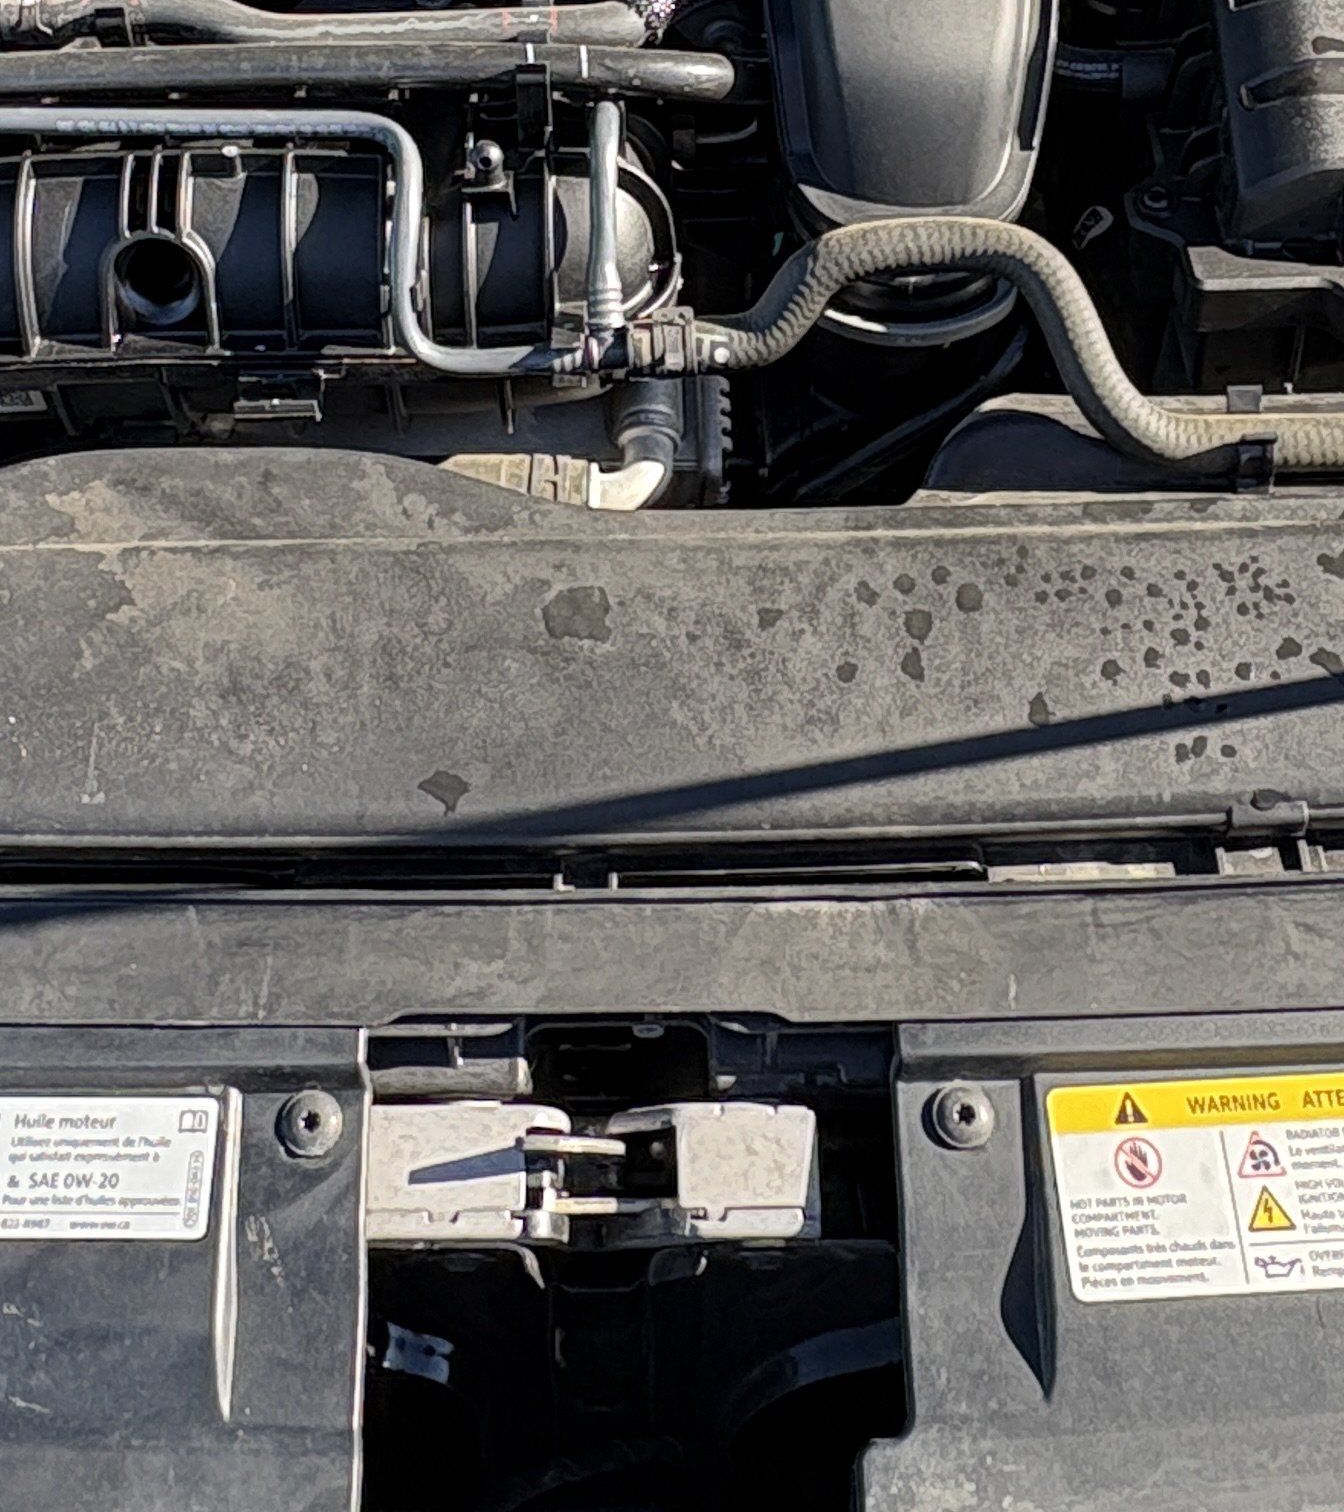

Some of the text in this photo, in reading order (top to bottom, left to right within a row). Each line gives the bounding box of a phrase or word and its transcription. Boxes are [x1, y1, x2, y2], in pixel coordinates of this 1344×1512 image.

[1186, 1092, 1281, 1115] WARNING
[13, 1113, 117, 1129] Huile moteur
[7, 1174, 21, 1189] &
[28, 1172, 60, 1189] SAE
[62, 1172, 121, 1189] 0W-20
[1146, 1193, 1188, 1207] MOTOR
